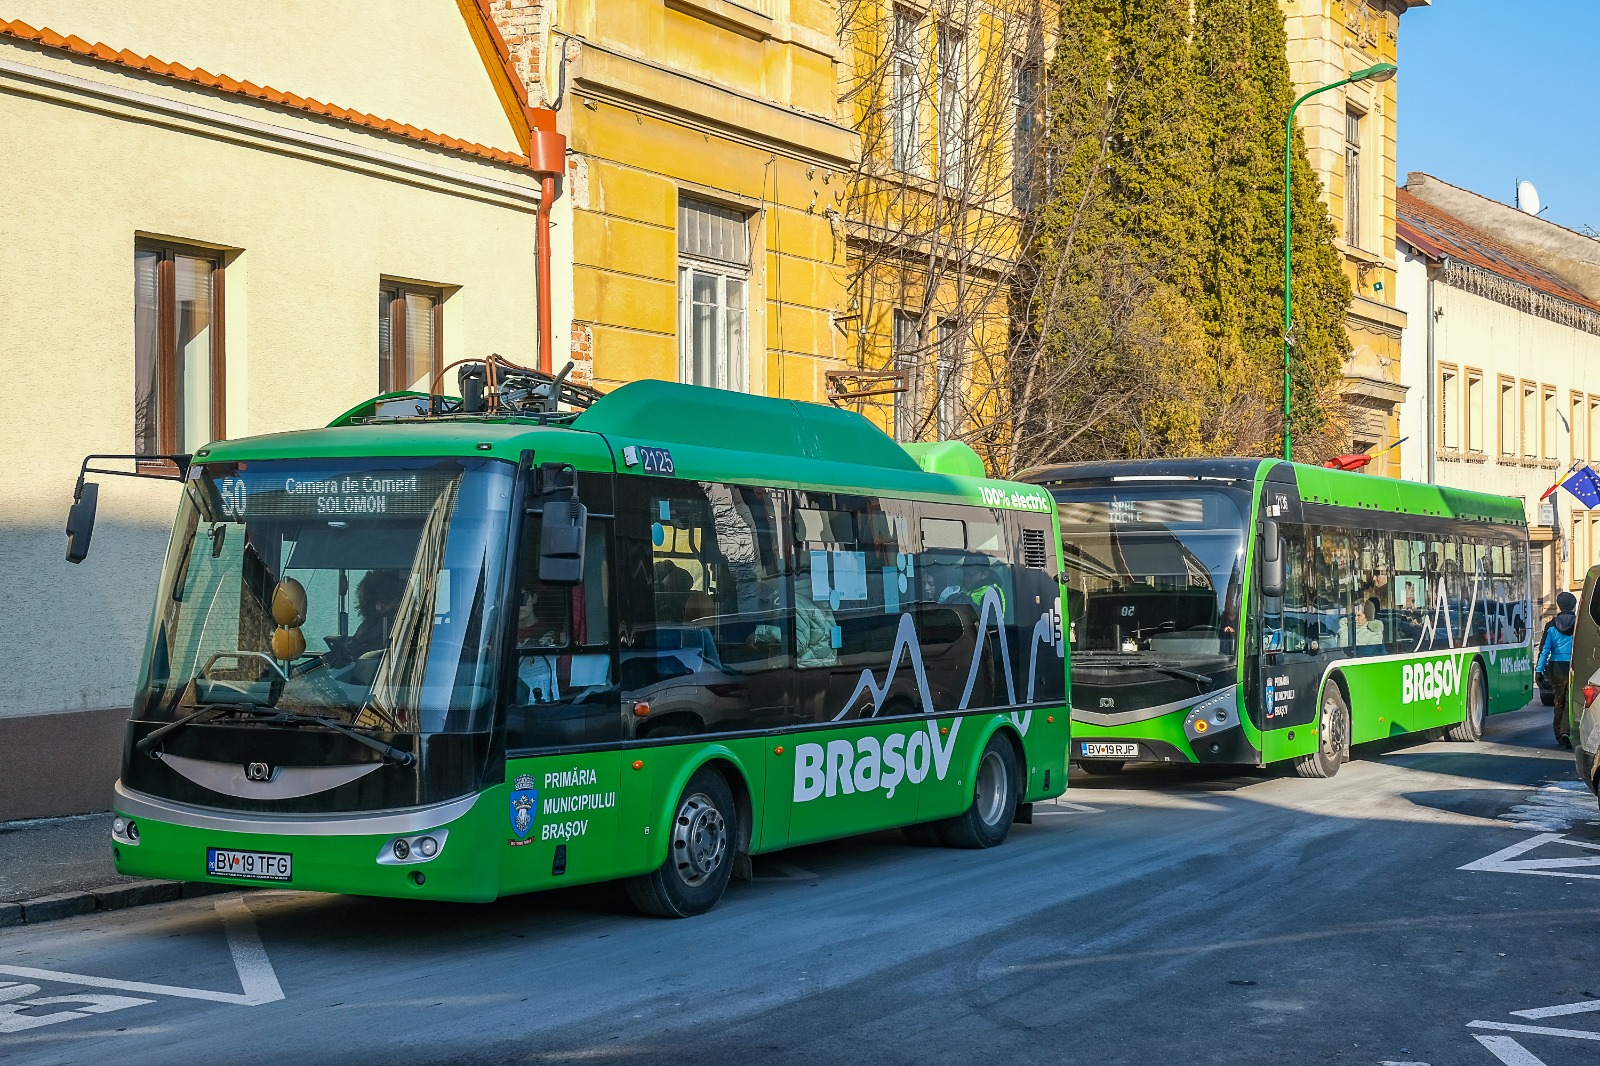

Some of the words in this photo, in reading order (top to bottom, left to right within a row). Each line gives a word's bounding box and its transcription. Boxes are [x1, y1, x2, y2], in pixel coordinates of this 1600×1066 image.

[640, 448, 674, 473] 2125
[285, 477, 338, 494] Camera
[341, 476, 359, 494] de
[362, 474, 418, 493] Comert
[221, 477, 247, 515] 50
[317, 495, 386, 513] SOLOMON
[978, 486, 1010, 507] 100%
[1011, 490, 1048, 511] electric
[1111, 500, 1136, 511] SPRE
[1088, 744, 1101, 755] BV
[1105, 744, 1114, 755] 19
[1115, 744, 1135, 755] RJP
[544, 766, 597, 789] PRIMĂRIA
[543, 791, 616, 815] MUNICIPIULUI
[216, 852, 236, 871] BV
[241, 854, 255, 872] 19
[258, 855, 288, 874] TFG
